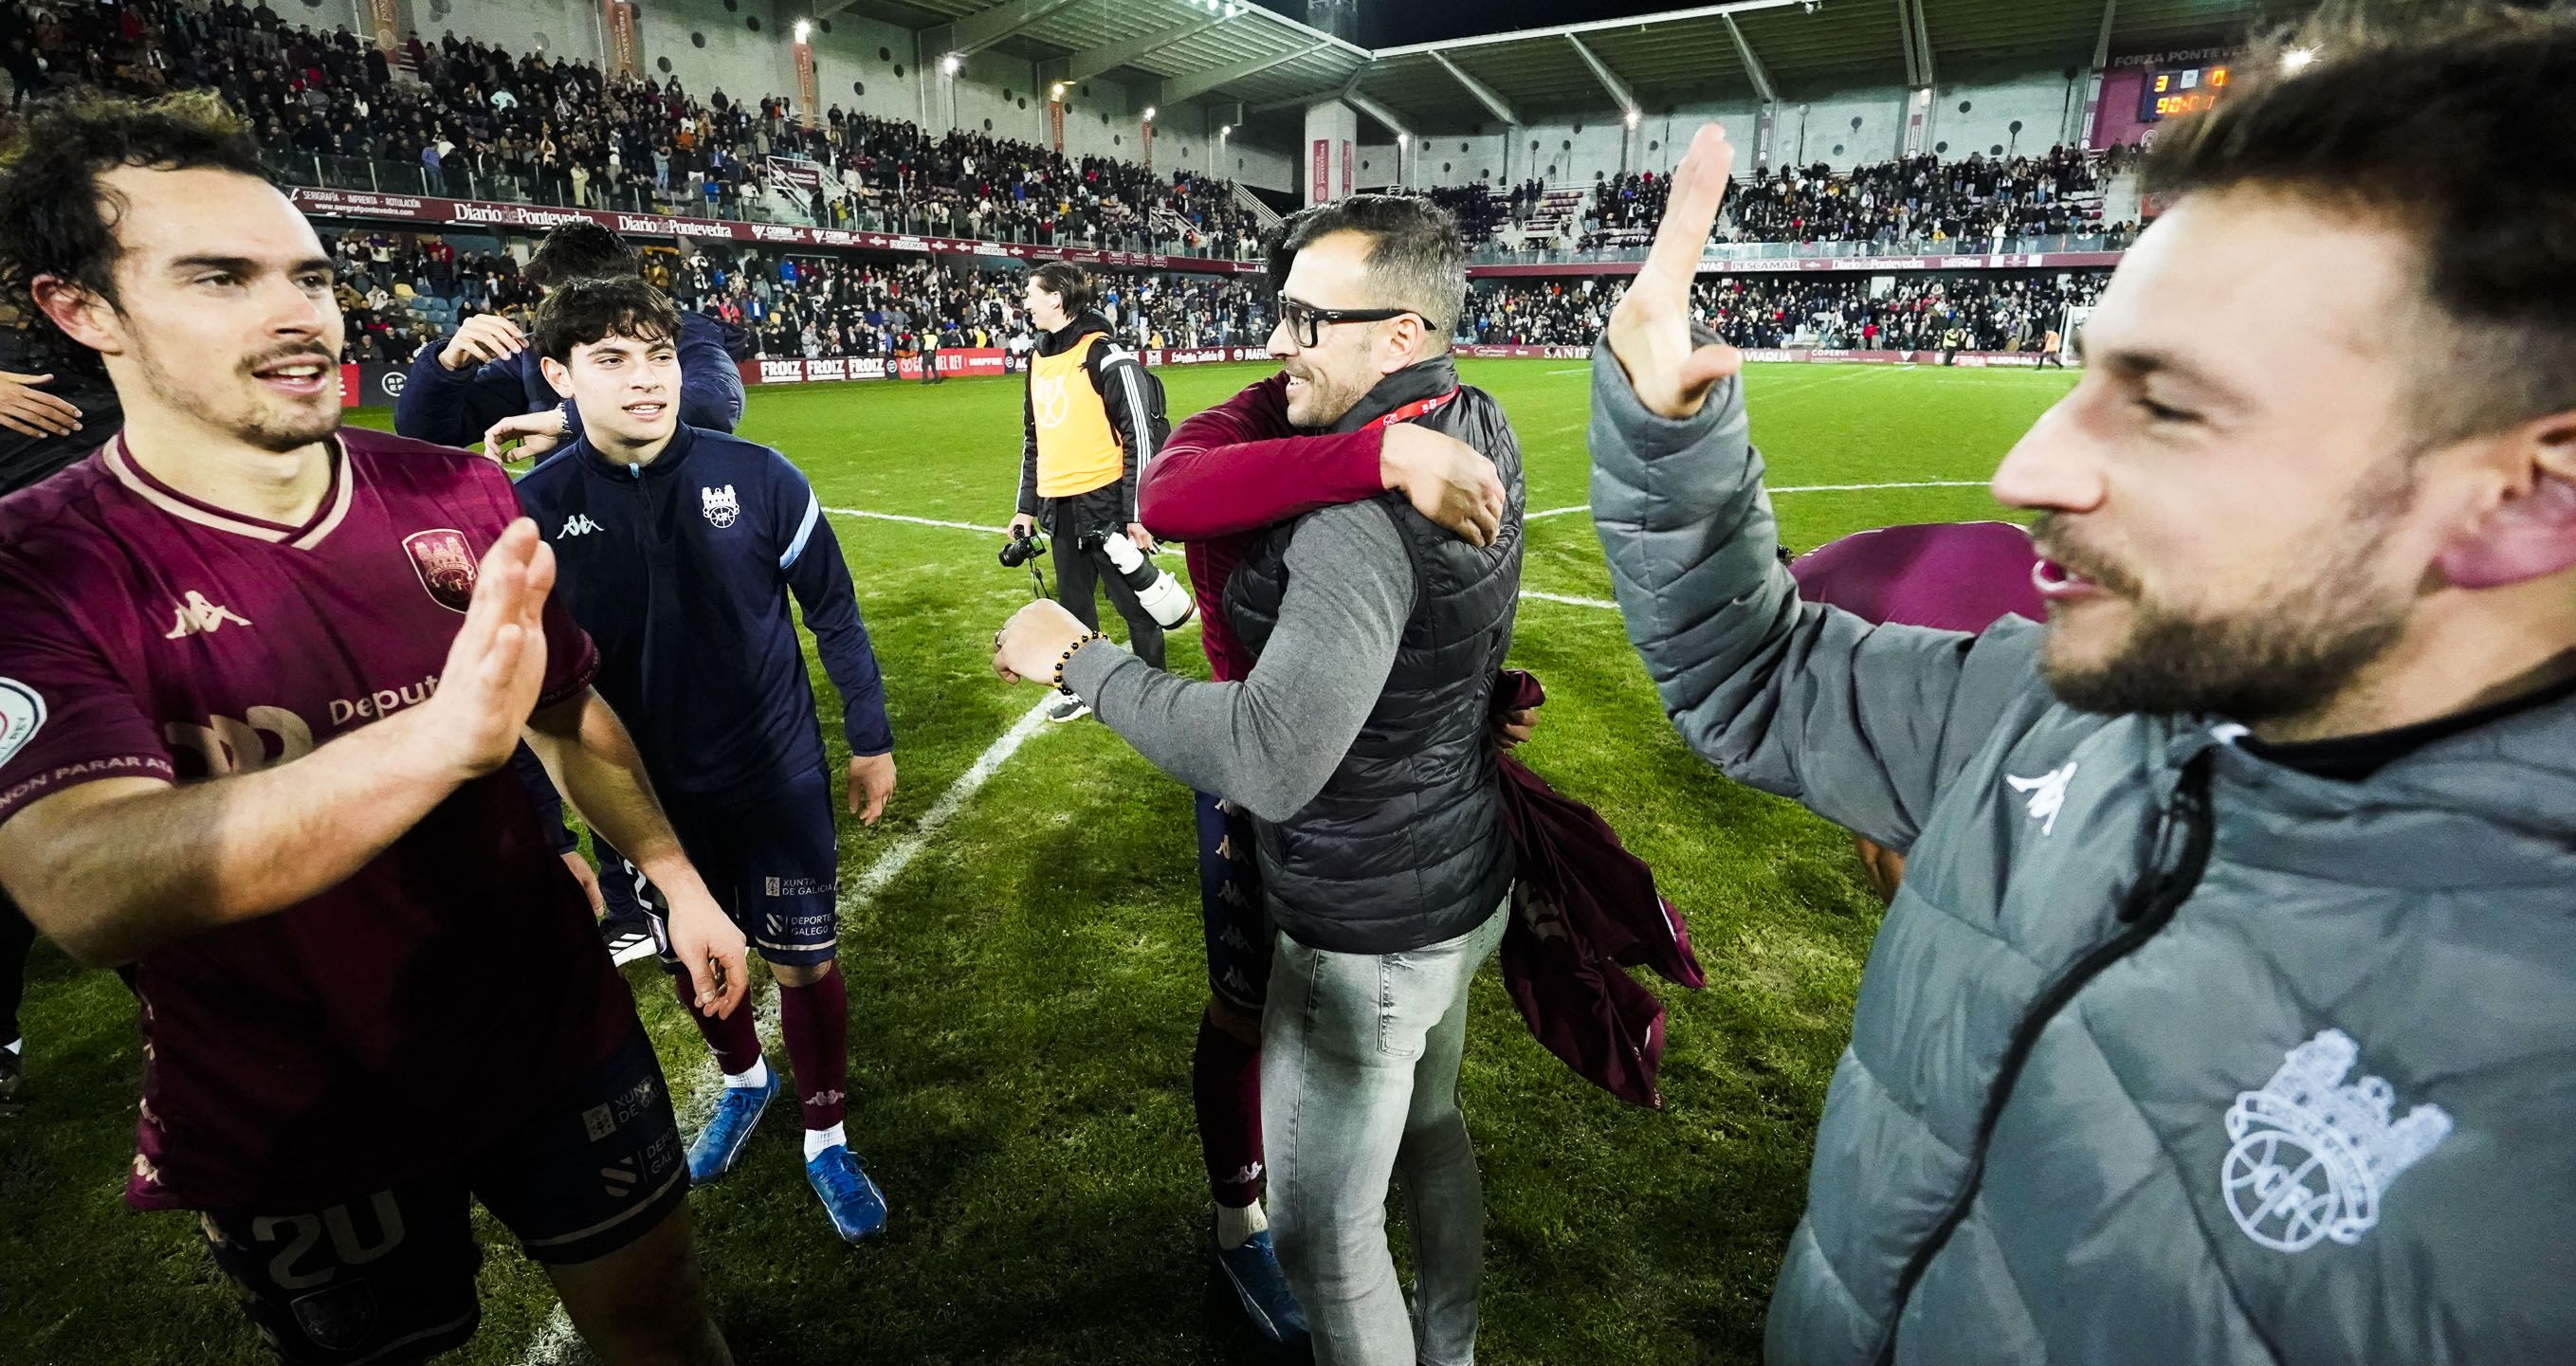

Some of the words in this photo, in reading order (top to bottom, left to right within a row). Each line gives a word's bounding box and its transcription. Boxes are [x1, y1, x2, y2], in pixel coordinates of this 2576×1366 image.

[2114, 52, 2164, 66] FORZA
[2154, 75, 2168, 92] 3
[2212, 70, 2225, 87] 0
[302, 190, 340, 202] SERIGRAFÍA
[347, 194, 378, 205] IMPRENTA
[386, 197, 421, 208] ROTULACIÓN
[1730, 260, 1800, 271] PESCAMAR
[760, 361, 802, 376] FROIZ
[806, 359, 845, 374] FROIZ
[849, 358, 885, 373] FROIZ
[949, 355, 962, 370] REY
[969, 356, 1003, 367] MAPFRE
[54, 756, 141, 780] PARAR
[782, 877, 816, 886] XUNTA
[782, 887, 795, 896] DE
[797, 883, 832, 895] GALICIA
[791, 913, 832, 925] DEPORTE
[791, 925, 829, 936] GALEGO
[252, 1189, 406, 1290] 20
